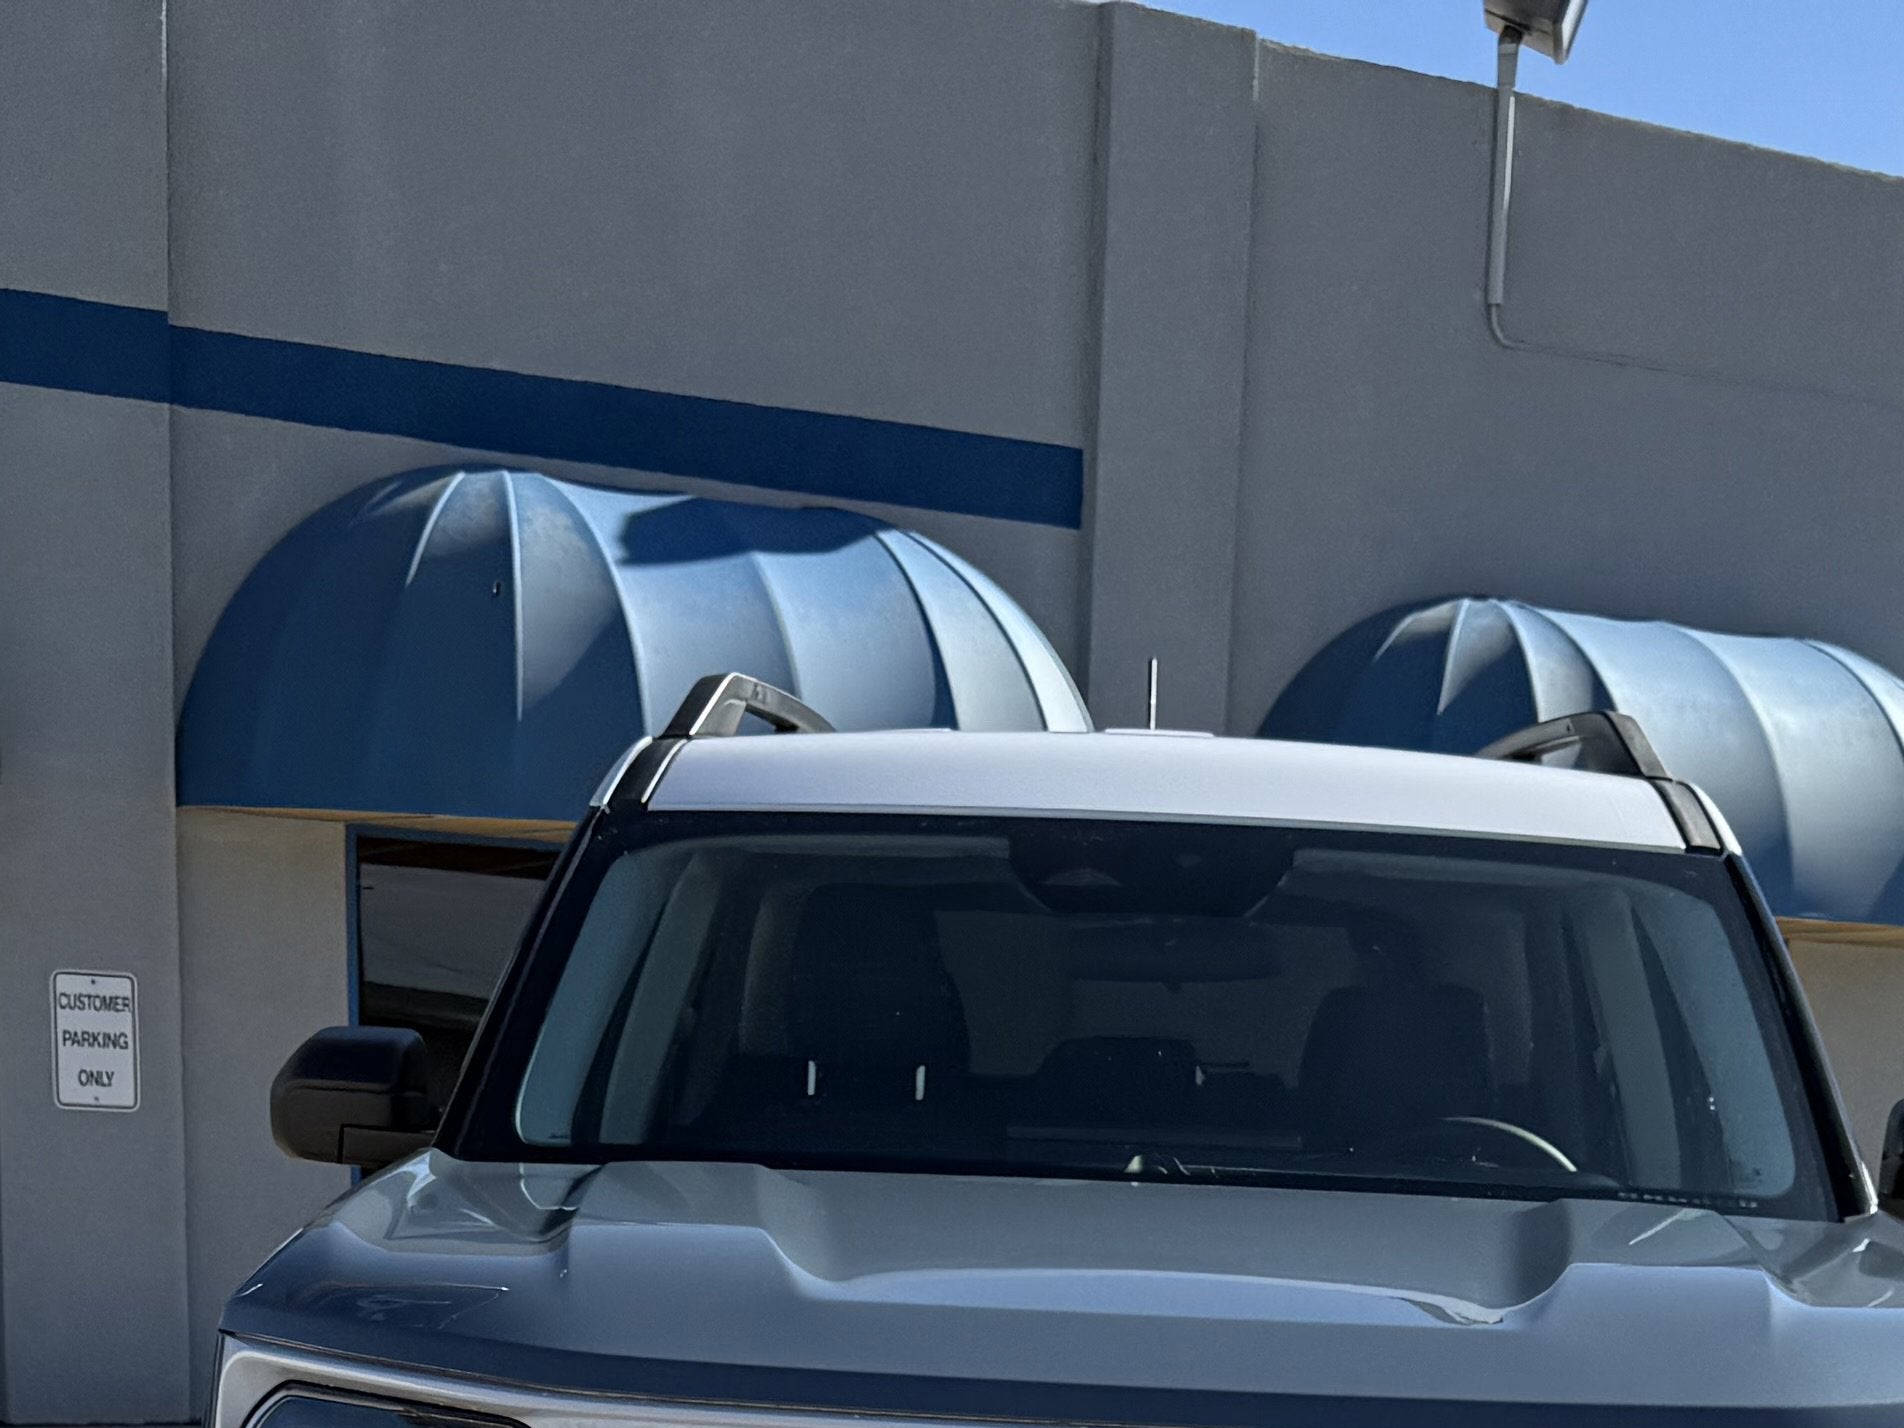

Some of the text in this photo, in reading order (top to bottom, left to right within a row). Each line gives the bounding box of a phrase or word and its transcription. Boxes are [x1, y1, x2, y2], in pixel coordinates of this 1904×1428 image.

[58, 992, 131, 1012] CUSTOMER
[62, 1029, 129, 1050] PARKING
[78, 1069, 115, 1087] ONLY
